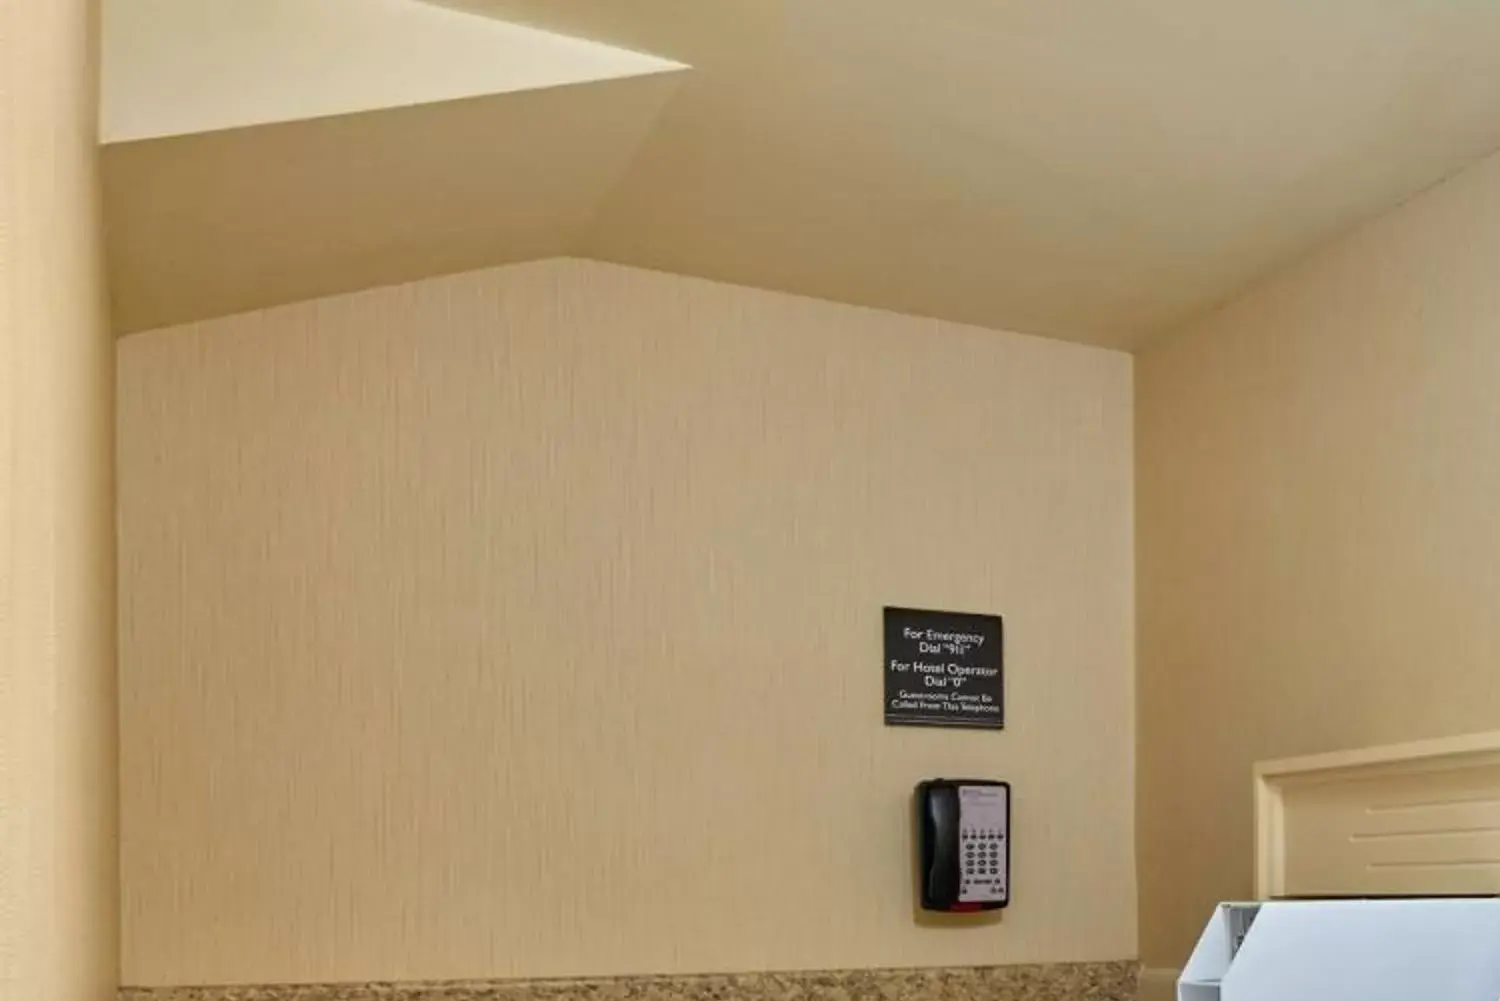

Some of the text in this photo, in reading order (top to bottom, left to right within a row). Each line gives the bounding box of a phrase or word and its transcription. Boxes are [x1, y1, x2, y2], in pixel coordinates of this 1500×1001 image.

[903, 627, 985, 646] For Emergency
[919, 641, 941, 653] Dial
[890, 659, 999, 676] For Hotel Operator
[925, 675, 947, 687] Dial
